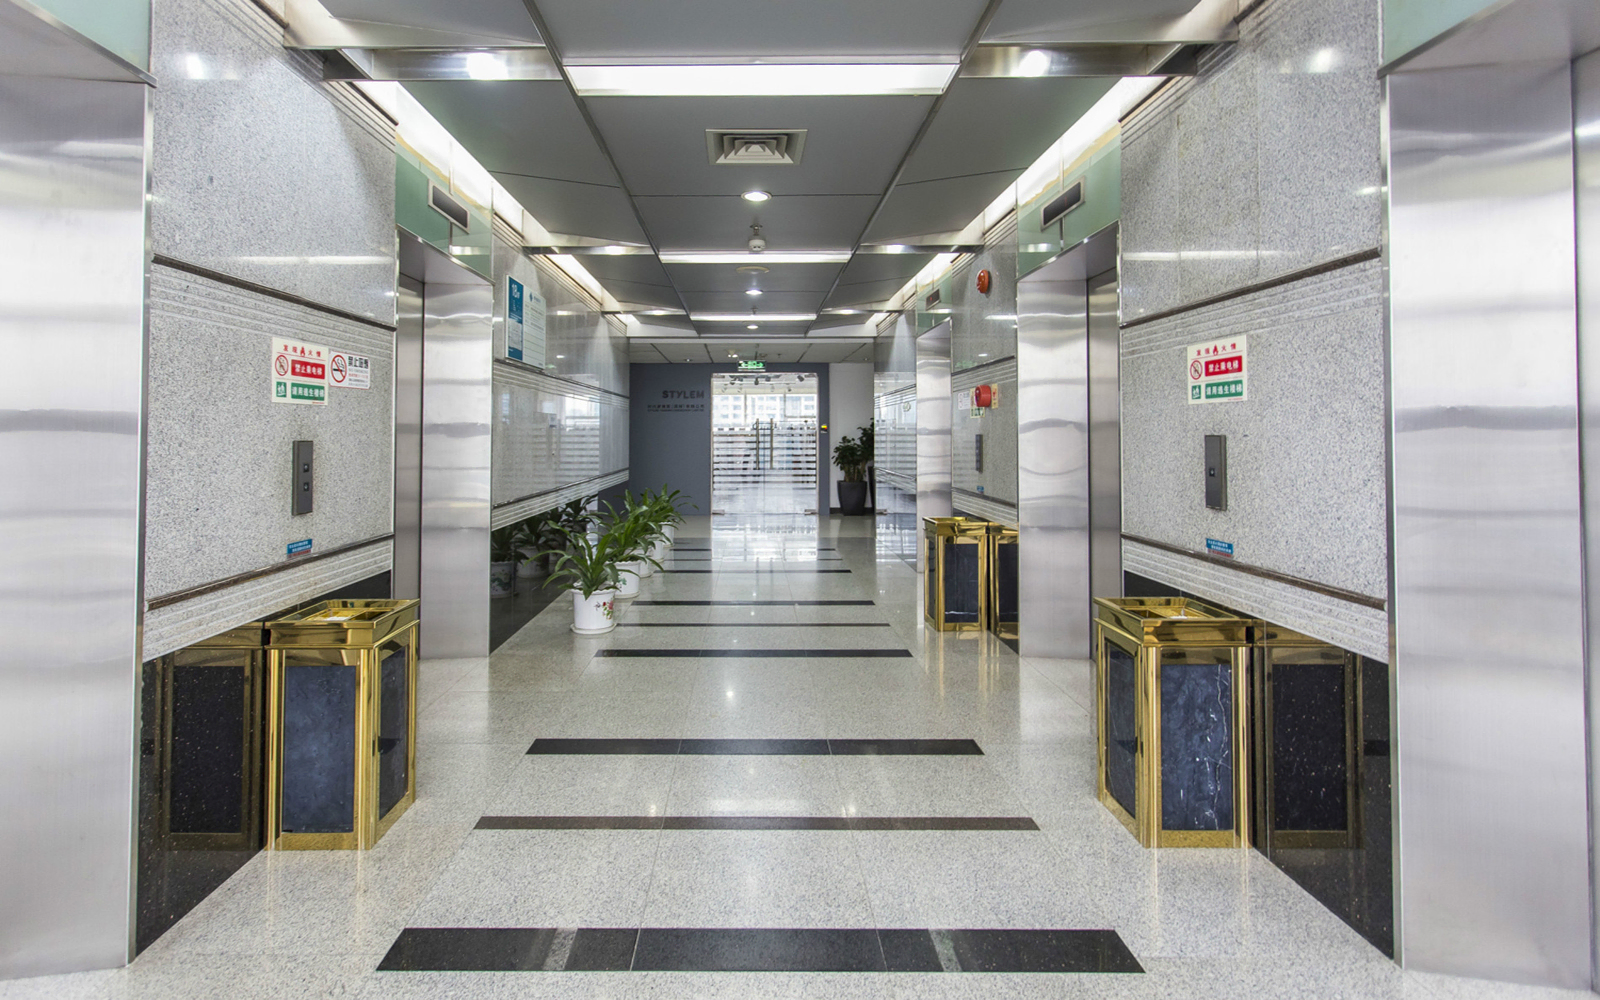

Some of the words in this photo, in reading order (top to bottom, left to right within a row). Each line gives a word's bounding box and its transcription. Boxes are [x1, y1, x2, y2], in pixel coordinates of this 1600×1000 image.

[294, 363, 323, 376] 禁止乘电梯
[1208, 360, 1239, 373] 禁止乘电梯
[662, 390, 705, 399] STYLEM
